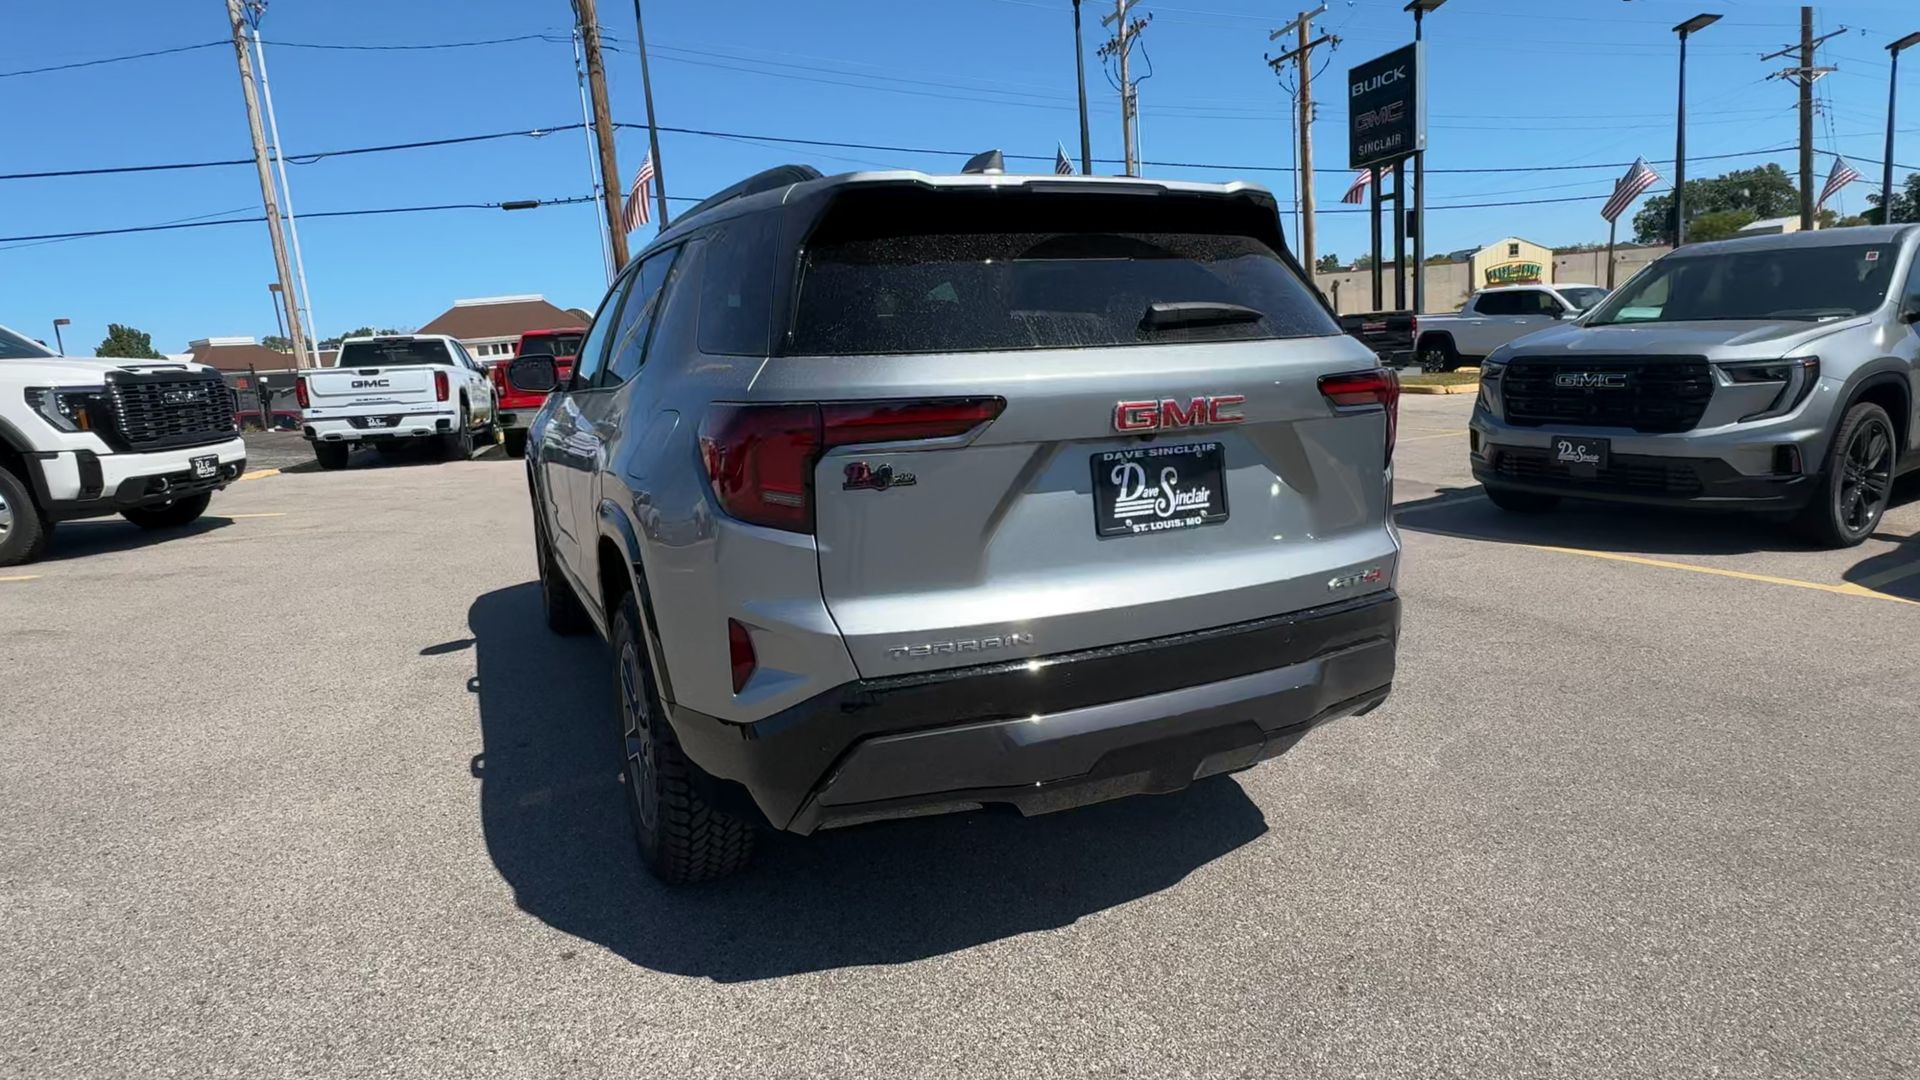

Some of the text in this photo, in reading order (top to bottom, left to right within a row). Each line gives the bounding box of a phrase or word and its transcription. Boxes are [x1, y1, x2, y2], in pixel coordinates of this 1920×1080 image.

[1351, 65, 1406, 97] BUICK
[1355, 100, 1405, 131] GMC
[1358, 134, 1402, 156] SINCLAIR
[351, 379, 390, 388] GMC
[1555, 373, 1627, 387] GMC
[1114, 395, 1247, 431] GMC
[1103, 443, 1217, 462] DAVE SINCLAIR
[1110, 462, 1211, 518] Dave Sinclair
[1132, 520, 1149, 533] ST.
[1186, 516, 1203, 527] MO
[887, 633, 1034, 657] TERRAIN
